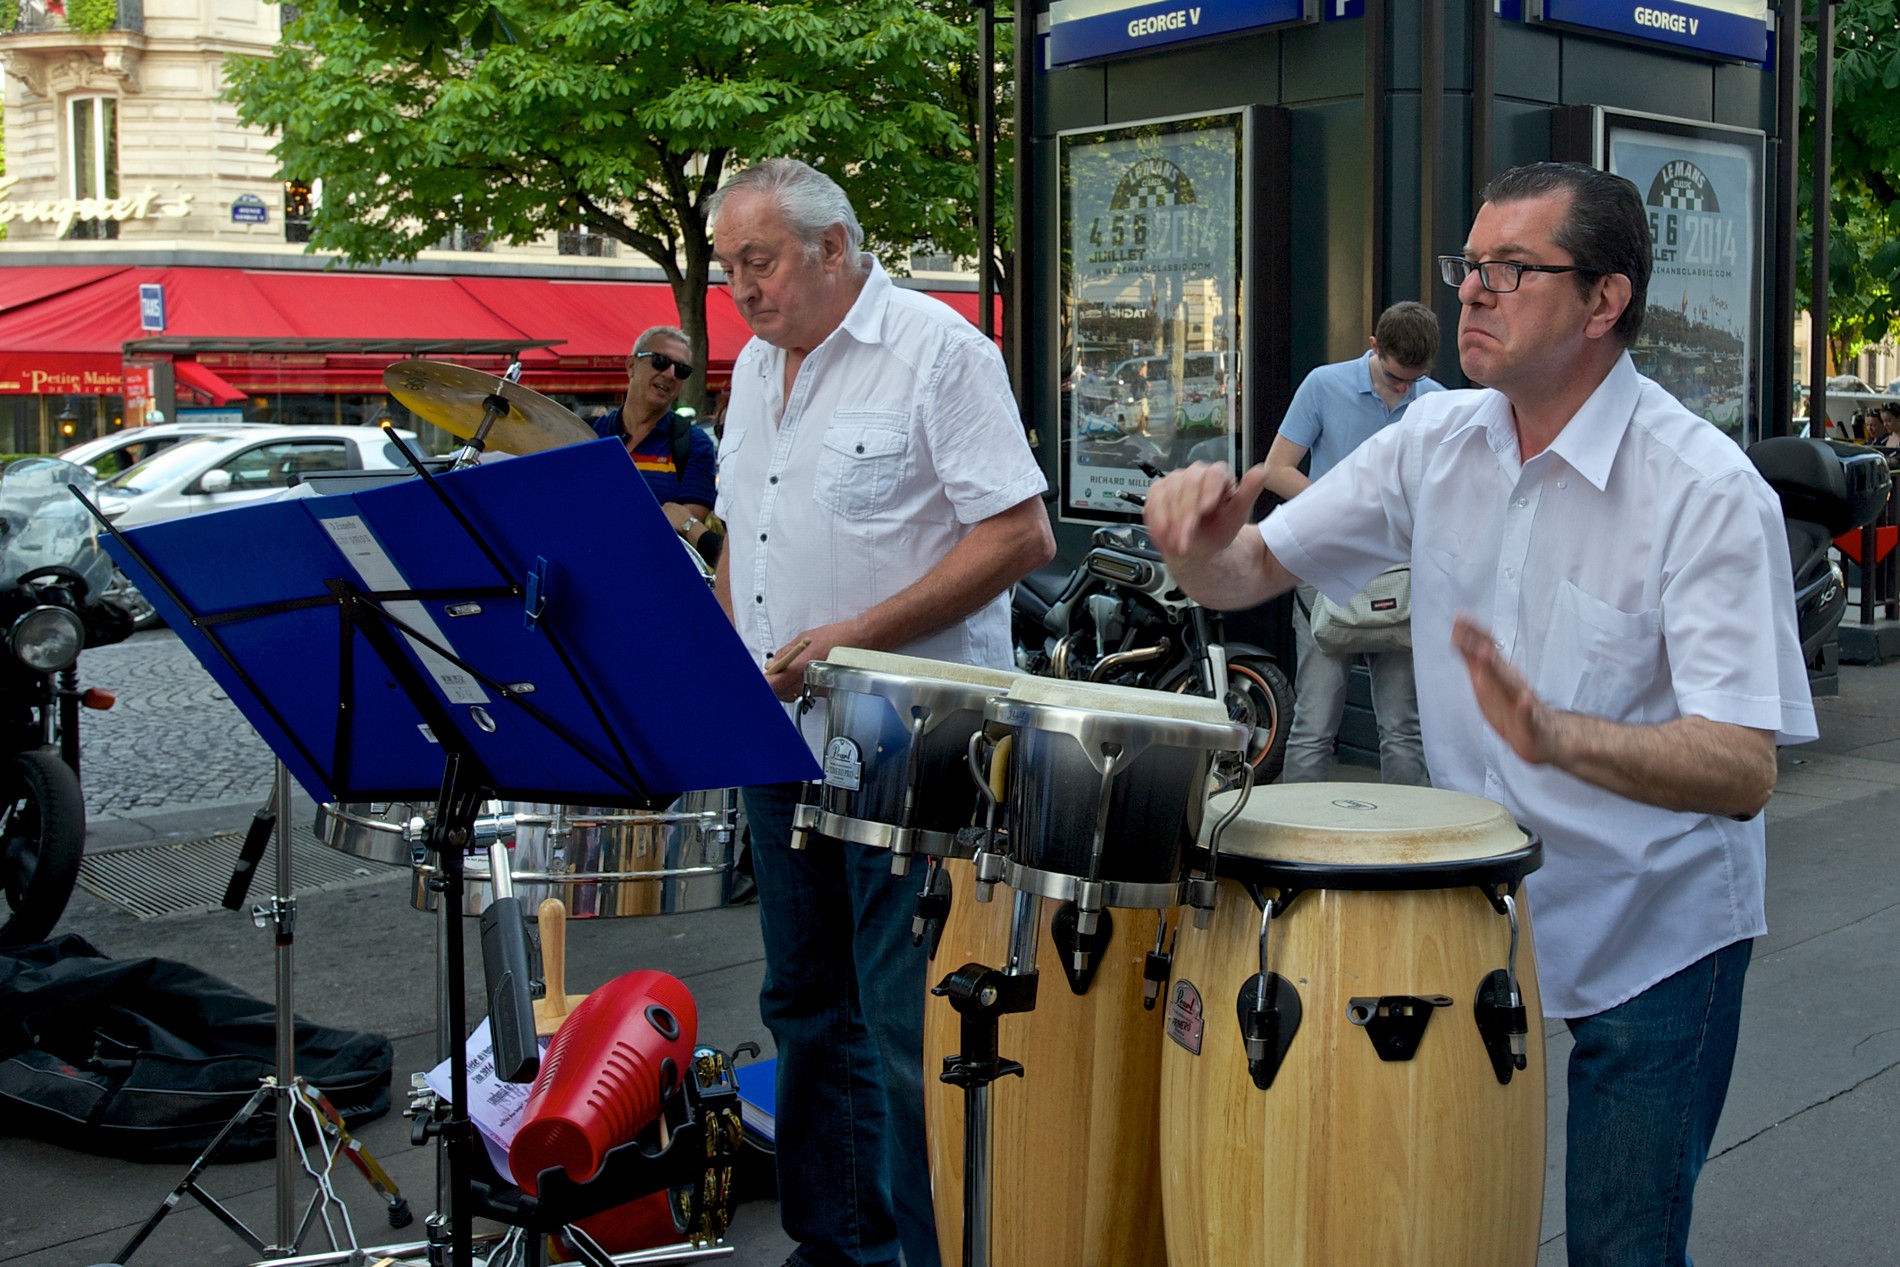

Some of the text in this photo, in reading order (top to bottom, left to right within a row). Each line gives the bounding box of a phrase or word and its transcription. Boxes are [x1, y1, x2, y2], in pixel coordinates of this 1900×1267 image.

[1128, 7, 1201, 37] GEORGE V
[1634, 6, 1699, 36] GEORGE V
[1673, 180, 1692, 189] CLASSIC
[1089, 217, 1102, 247] 4
[1112, 215, 1124, 246] 5
[1134, 213, 1147, 245] 6
[1650, 212, 1737, 266] 5 6 2014
[1089, 248, 1146, 264] JUILLET
[31, 370, 80, 393] Petite
[84, 371, 124, 384] Maiso
[73, 383, 123, 393] NICO
[1090, 475, 1125, 486] RICHARD
[1176, 986, 1196, 1011] Pearl
